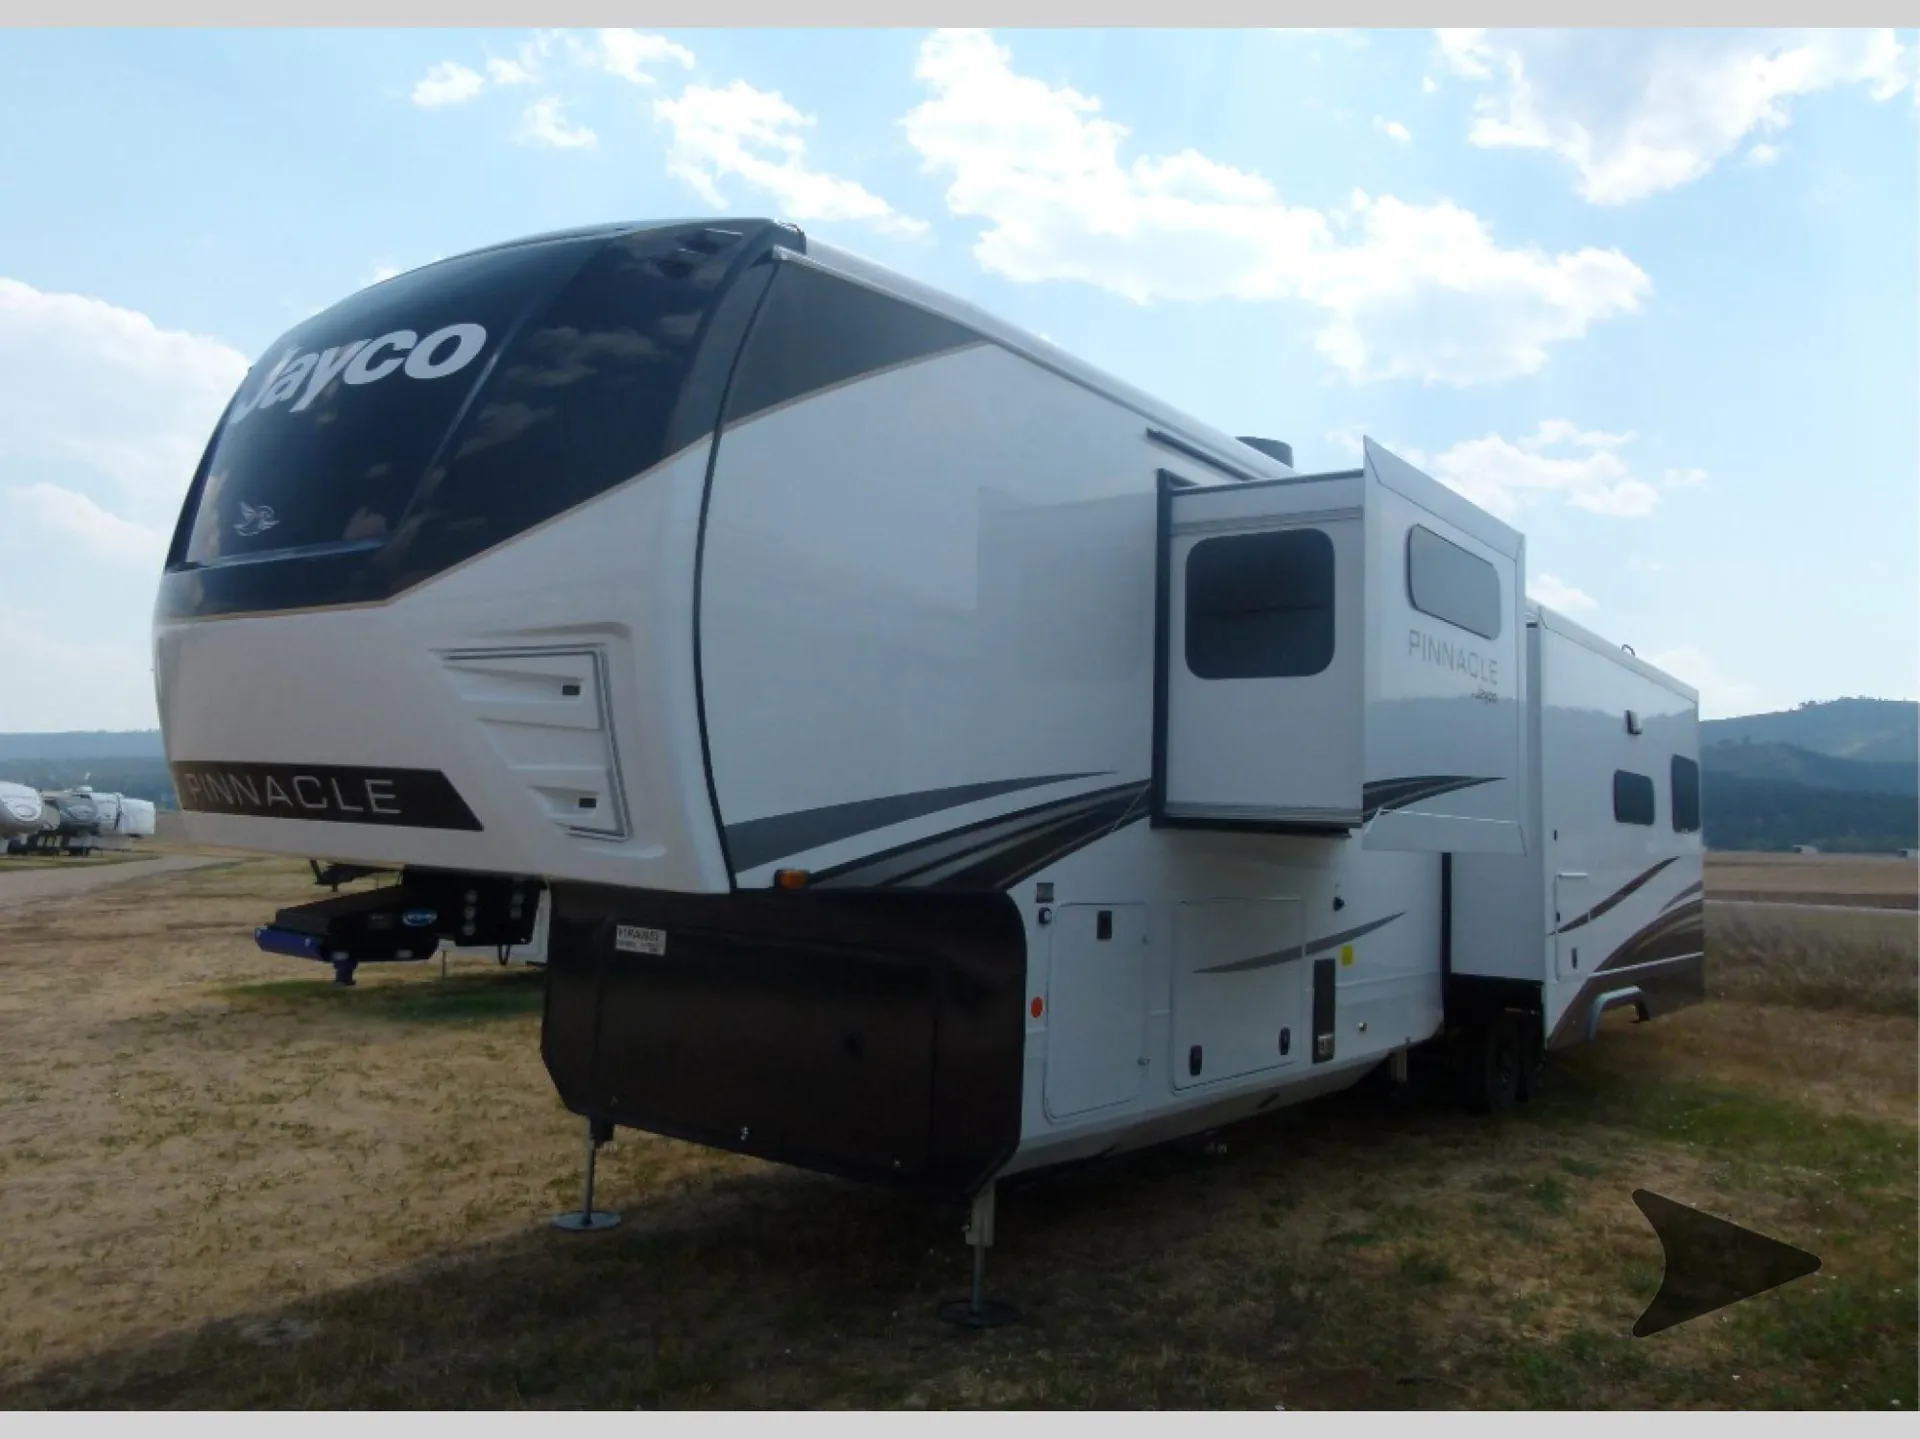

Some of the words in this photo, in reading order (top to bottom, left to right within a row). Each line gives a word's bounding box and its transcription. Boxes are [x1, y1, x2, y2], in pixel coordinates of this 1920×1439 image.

[229, 323, 487, 423] Jayco
[1408, 629, 1498, 686] PINNACLE
[184, 773, 402, 814] PINNACLE
